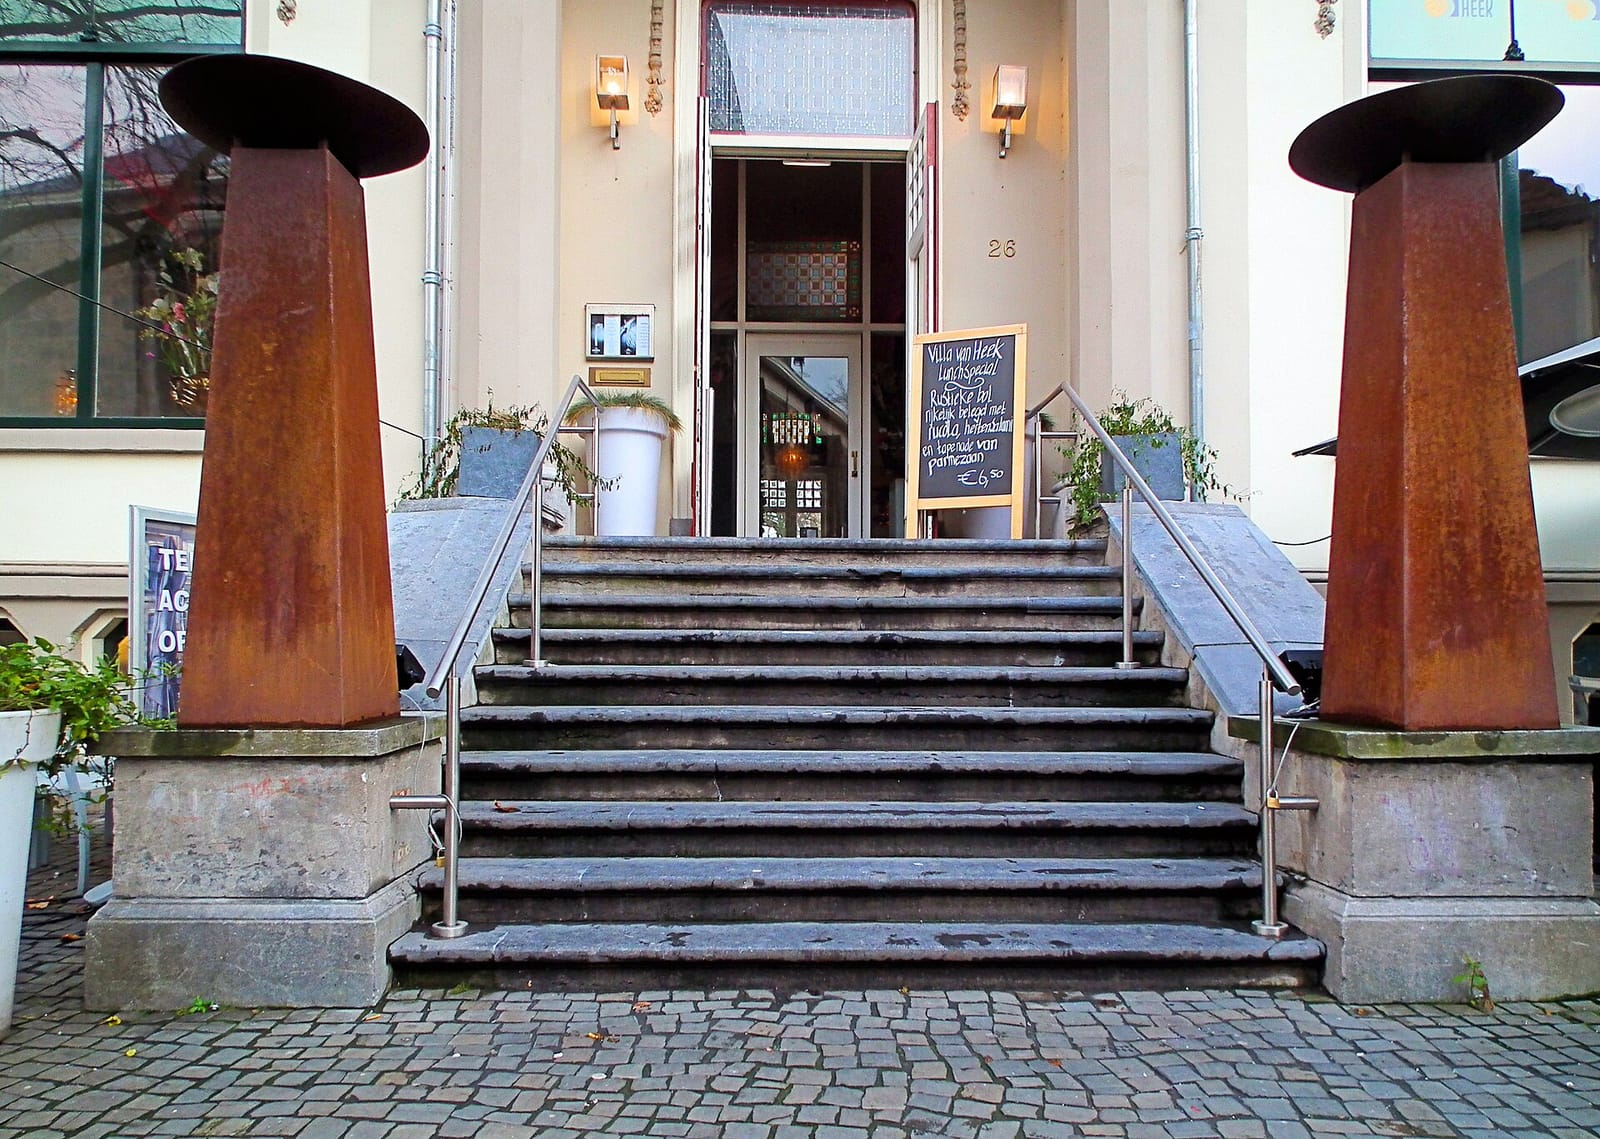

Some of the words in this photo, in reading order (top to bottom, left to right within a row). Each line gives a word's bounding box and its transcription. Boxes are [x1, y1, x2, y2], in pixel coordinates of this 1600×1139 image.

[988, 239, 1016, 258] 26
[928, 343, 952, 363] Villa
[956, 346, 971, 362] van
[973, 338, 1005, 360] Heek
[977, 385, 992, 403] bol
[959, 403, 987, 423] belegd
[989, 401, 1006, 416] met
[922, 445, 934, 457] en
[937, 438, 974, 458] tapenade
[977, 439, 998, 450] van
[928, 452, 984, 476] parmezaan
[158, 547, 193, 572] TE
